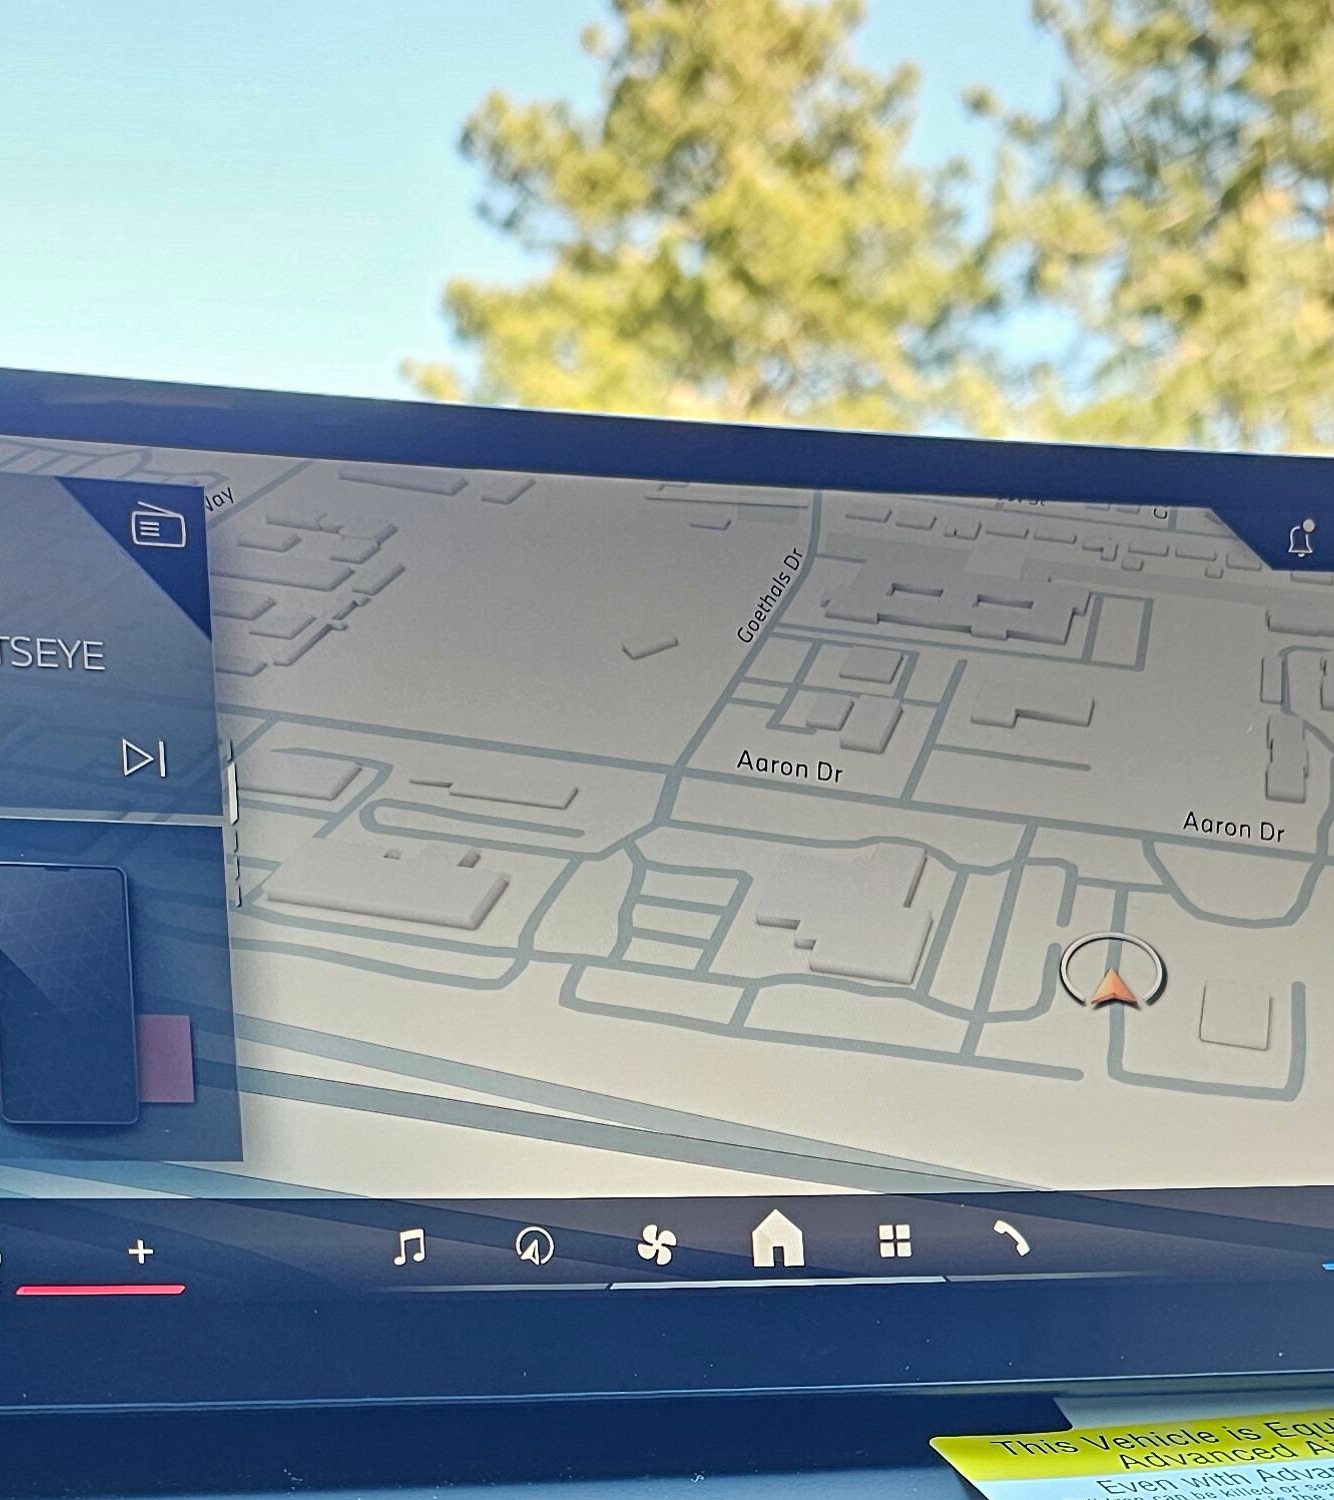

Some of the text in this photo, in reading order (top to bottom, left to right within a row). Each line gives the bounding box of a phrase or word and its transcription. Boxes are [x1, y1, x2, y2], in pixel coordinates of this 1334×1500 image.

[736, 547, 804, 644] Goethals Dr
[736, 749, 843, 784] Aaron Dr
[1183, 810, 1285, 843] Aaron Dr
[990, 1436, 1079, 1457] This
[1079, 1428, 1220, 1451] Vehicle
[1222, 1425, 1262, 1442] is
[1118, 1442, 1299, 1470] Advanced
[1095, 1479, 1180, 1495] Even
[1180, 1471, 1252, 1488] with
[1190, 1491, 1218, 1500] be
[1220, 1485, 1275, 1498] killed
[1279, 1485, 1301, 1495] or
